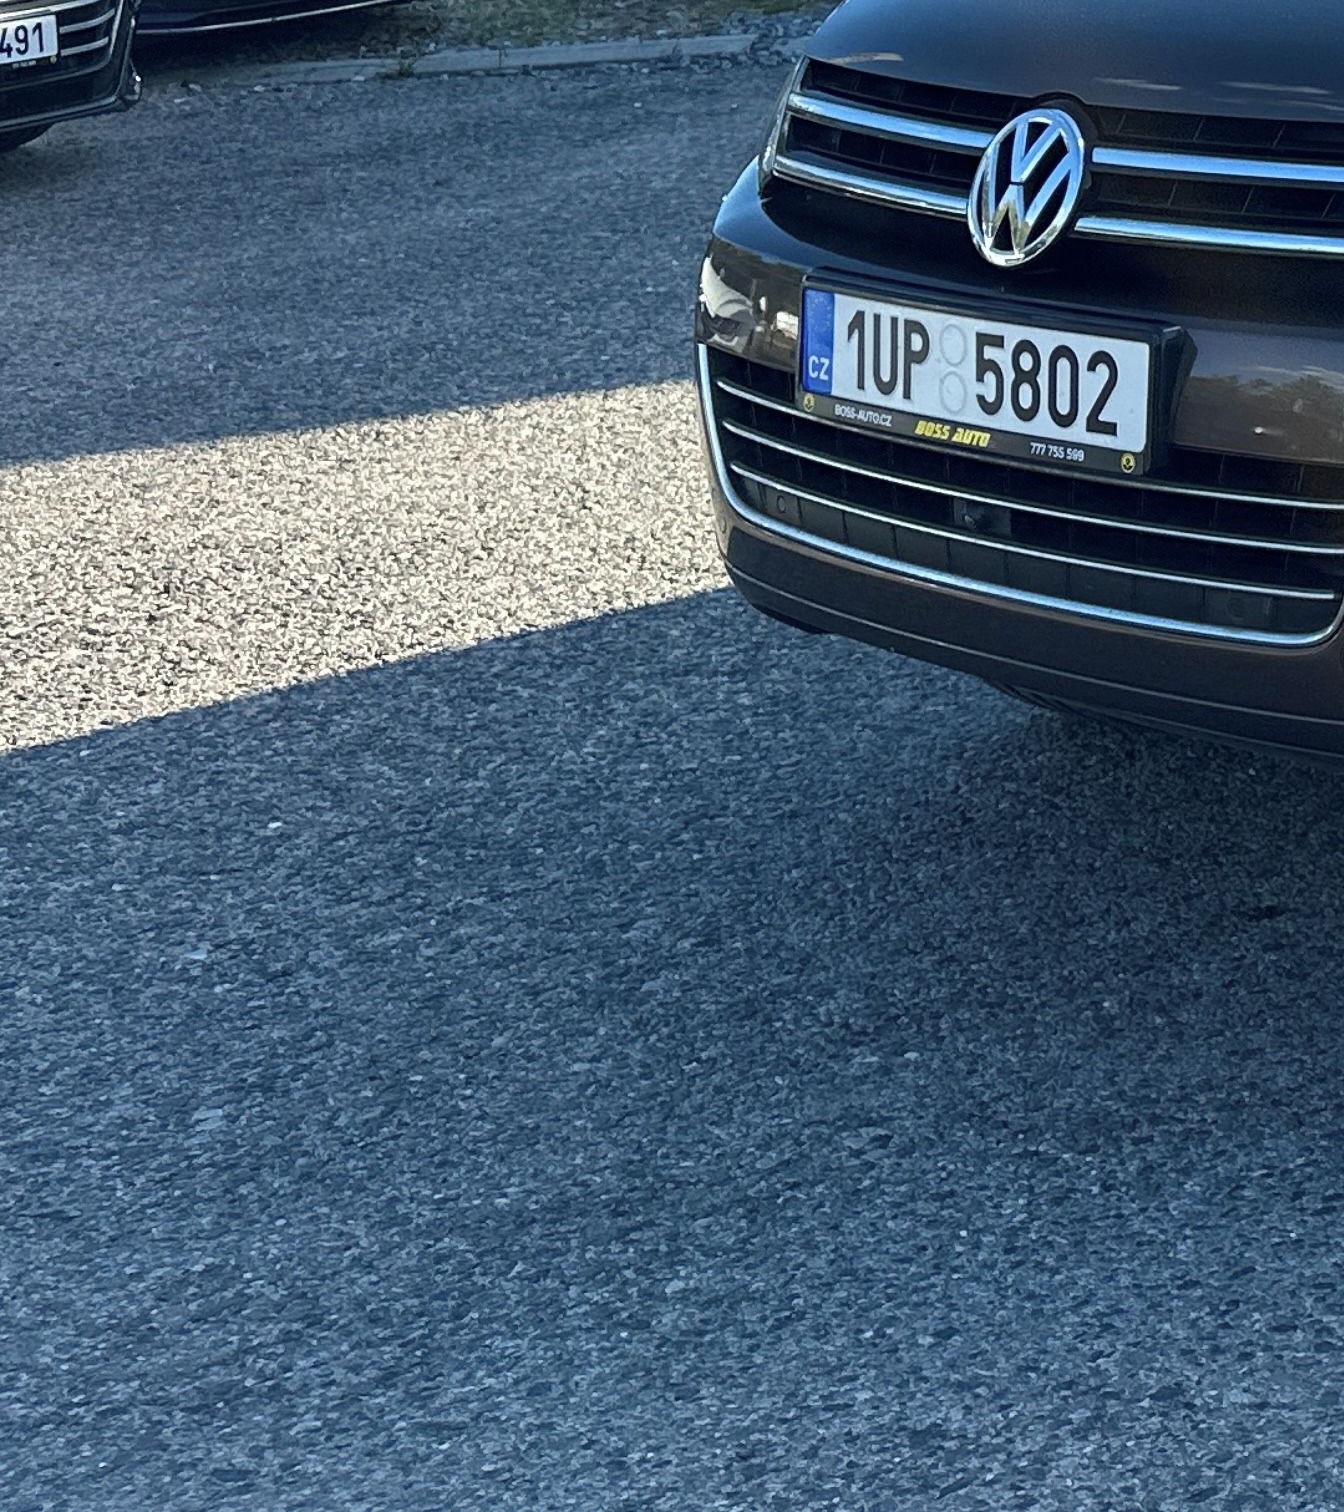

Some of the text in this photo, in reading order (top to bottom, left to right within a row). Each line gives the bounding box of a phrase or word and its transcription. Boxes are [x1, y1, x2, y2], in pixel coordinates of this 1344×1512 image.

[808, 356, 829, 380] CZ
[847, 310, 1118, 436] 1UP 5802
[915, 420, 991, 447] BOSS AUTO
[1030, 442, 1046, 455] 777
